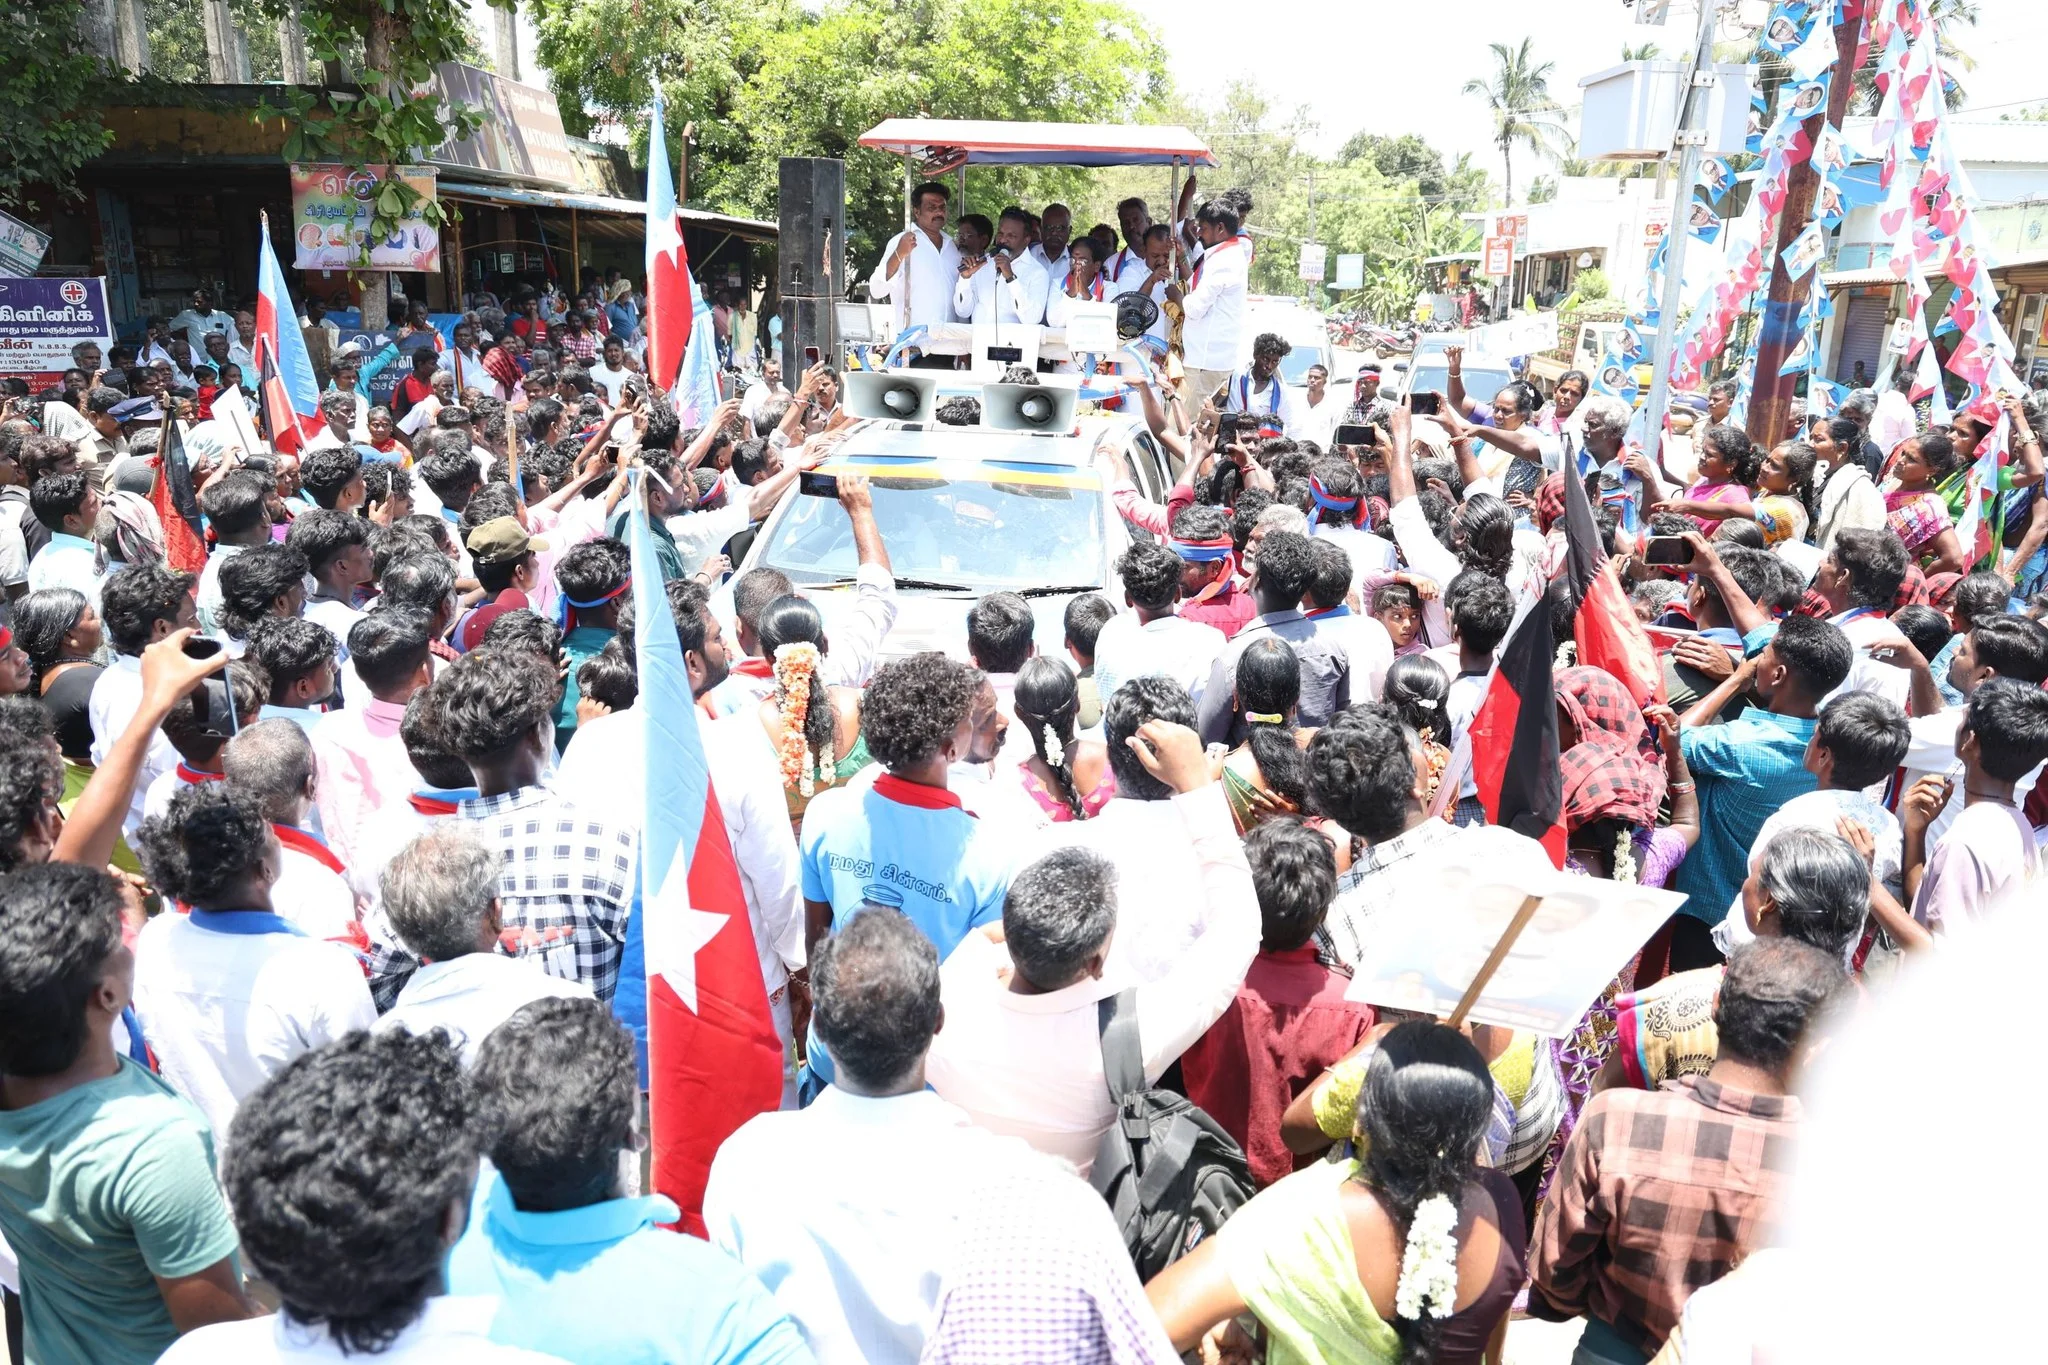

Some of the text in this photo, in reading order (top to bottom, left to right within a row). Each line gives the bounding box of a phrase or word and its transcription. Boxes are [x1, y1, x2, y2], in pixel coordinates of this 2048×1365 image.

[519, 125, 568, 151] NATIONAL
[21, 326, 38, 334] நல
[40, 325, 93, 334] மருத்துவம்
[829, 853, 875, 878] நமது
